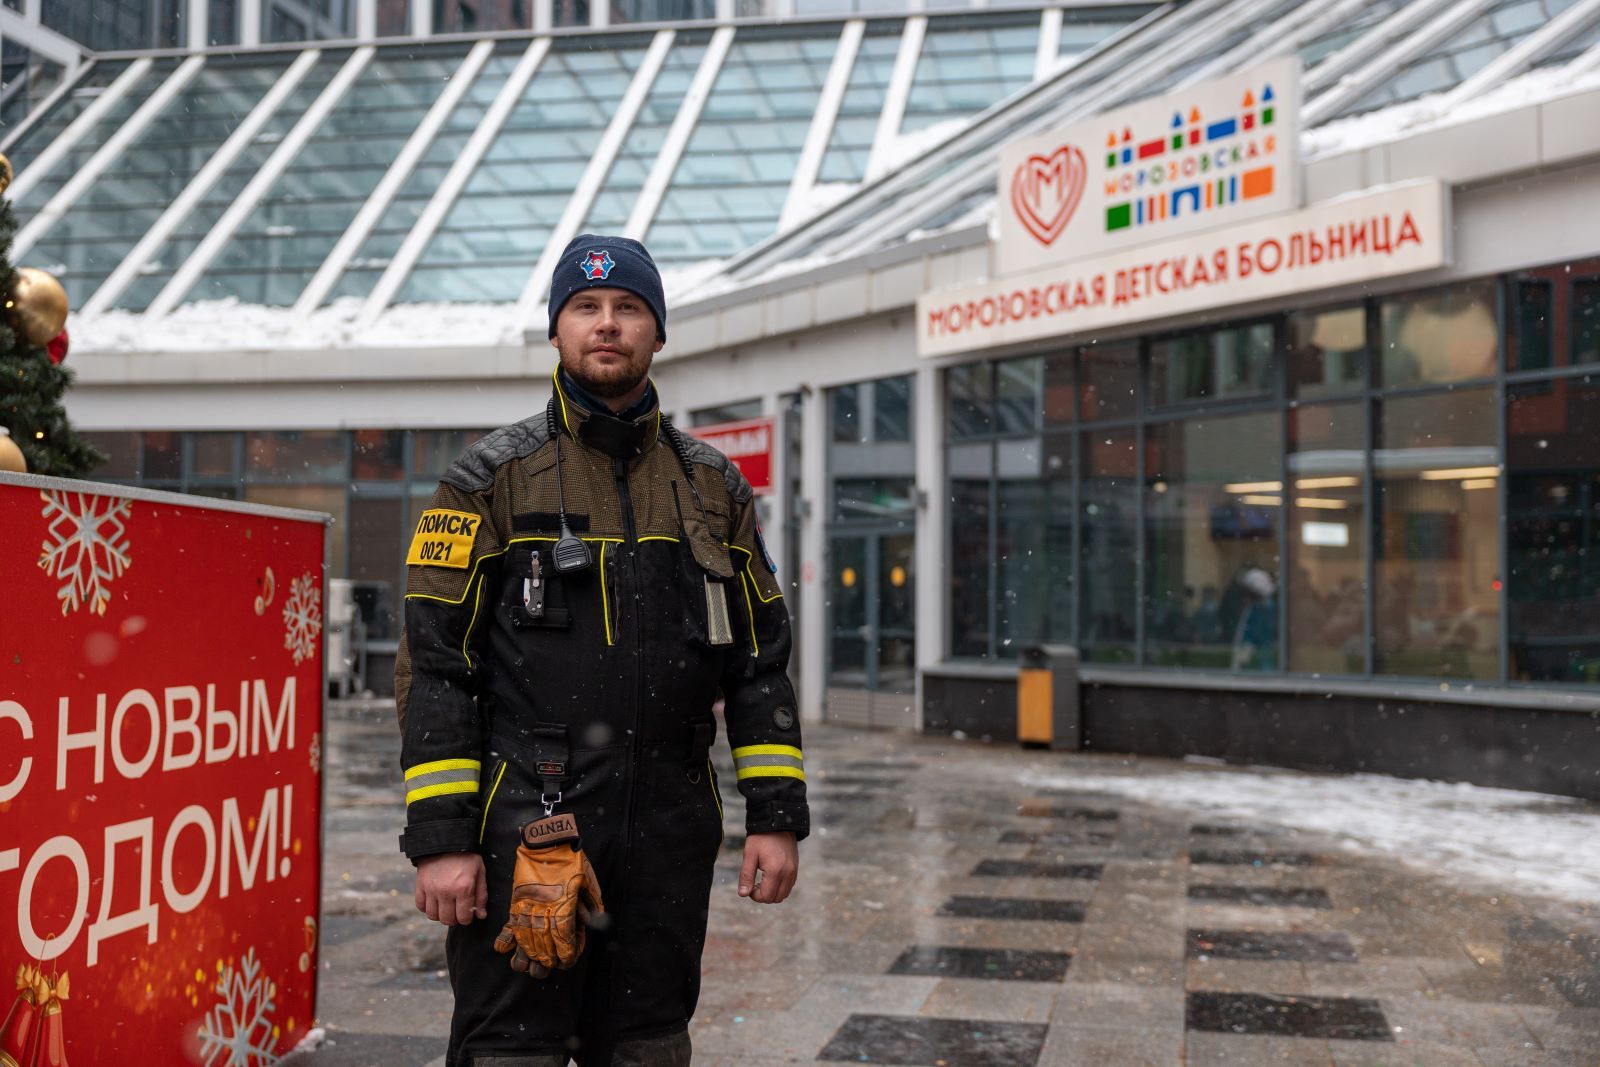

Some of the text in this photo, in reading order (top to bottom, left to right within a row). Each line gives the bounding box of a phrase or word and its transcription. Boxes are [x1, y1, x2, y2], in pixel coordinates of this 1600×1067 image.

[927, 212, 1422, 337] МОРОЗОВСКАЯ ДЕТСКАЯ БОЛЬНИЦА
[418, 514, 476, 536] ПОИСК
[420, 541, 453, 561] 0021
[56, 676, 297, 791] НОВЫМ
[529, 819, 574, 838] VENTO
